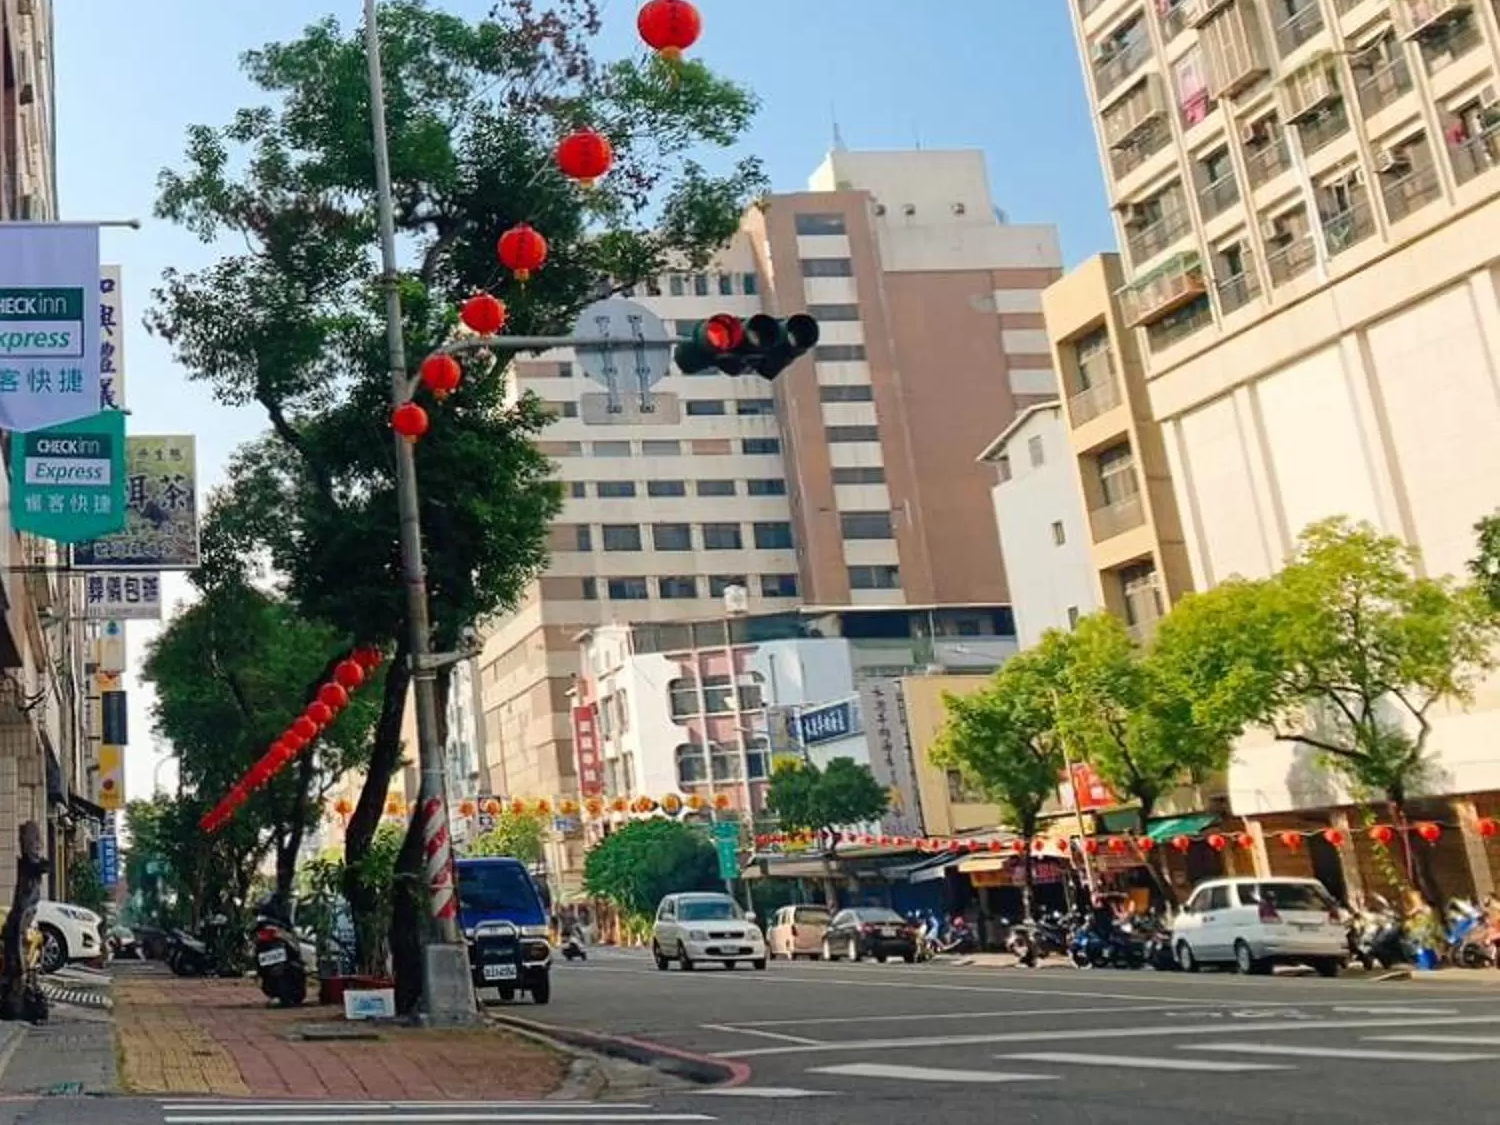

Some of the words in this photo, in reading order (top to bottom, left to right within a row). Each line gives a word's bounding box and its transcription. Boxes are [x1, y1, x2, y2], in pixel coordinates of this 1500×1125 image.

[34, 461, 102, 483] Express
[25, 493, 111, 514] 雀客快捷
